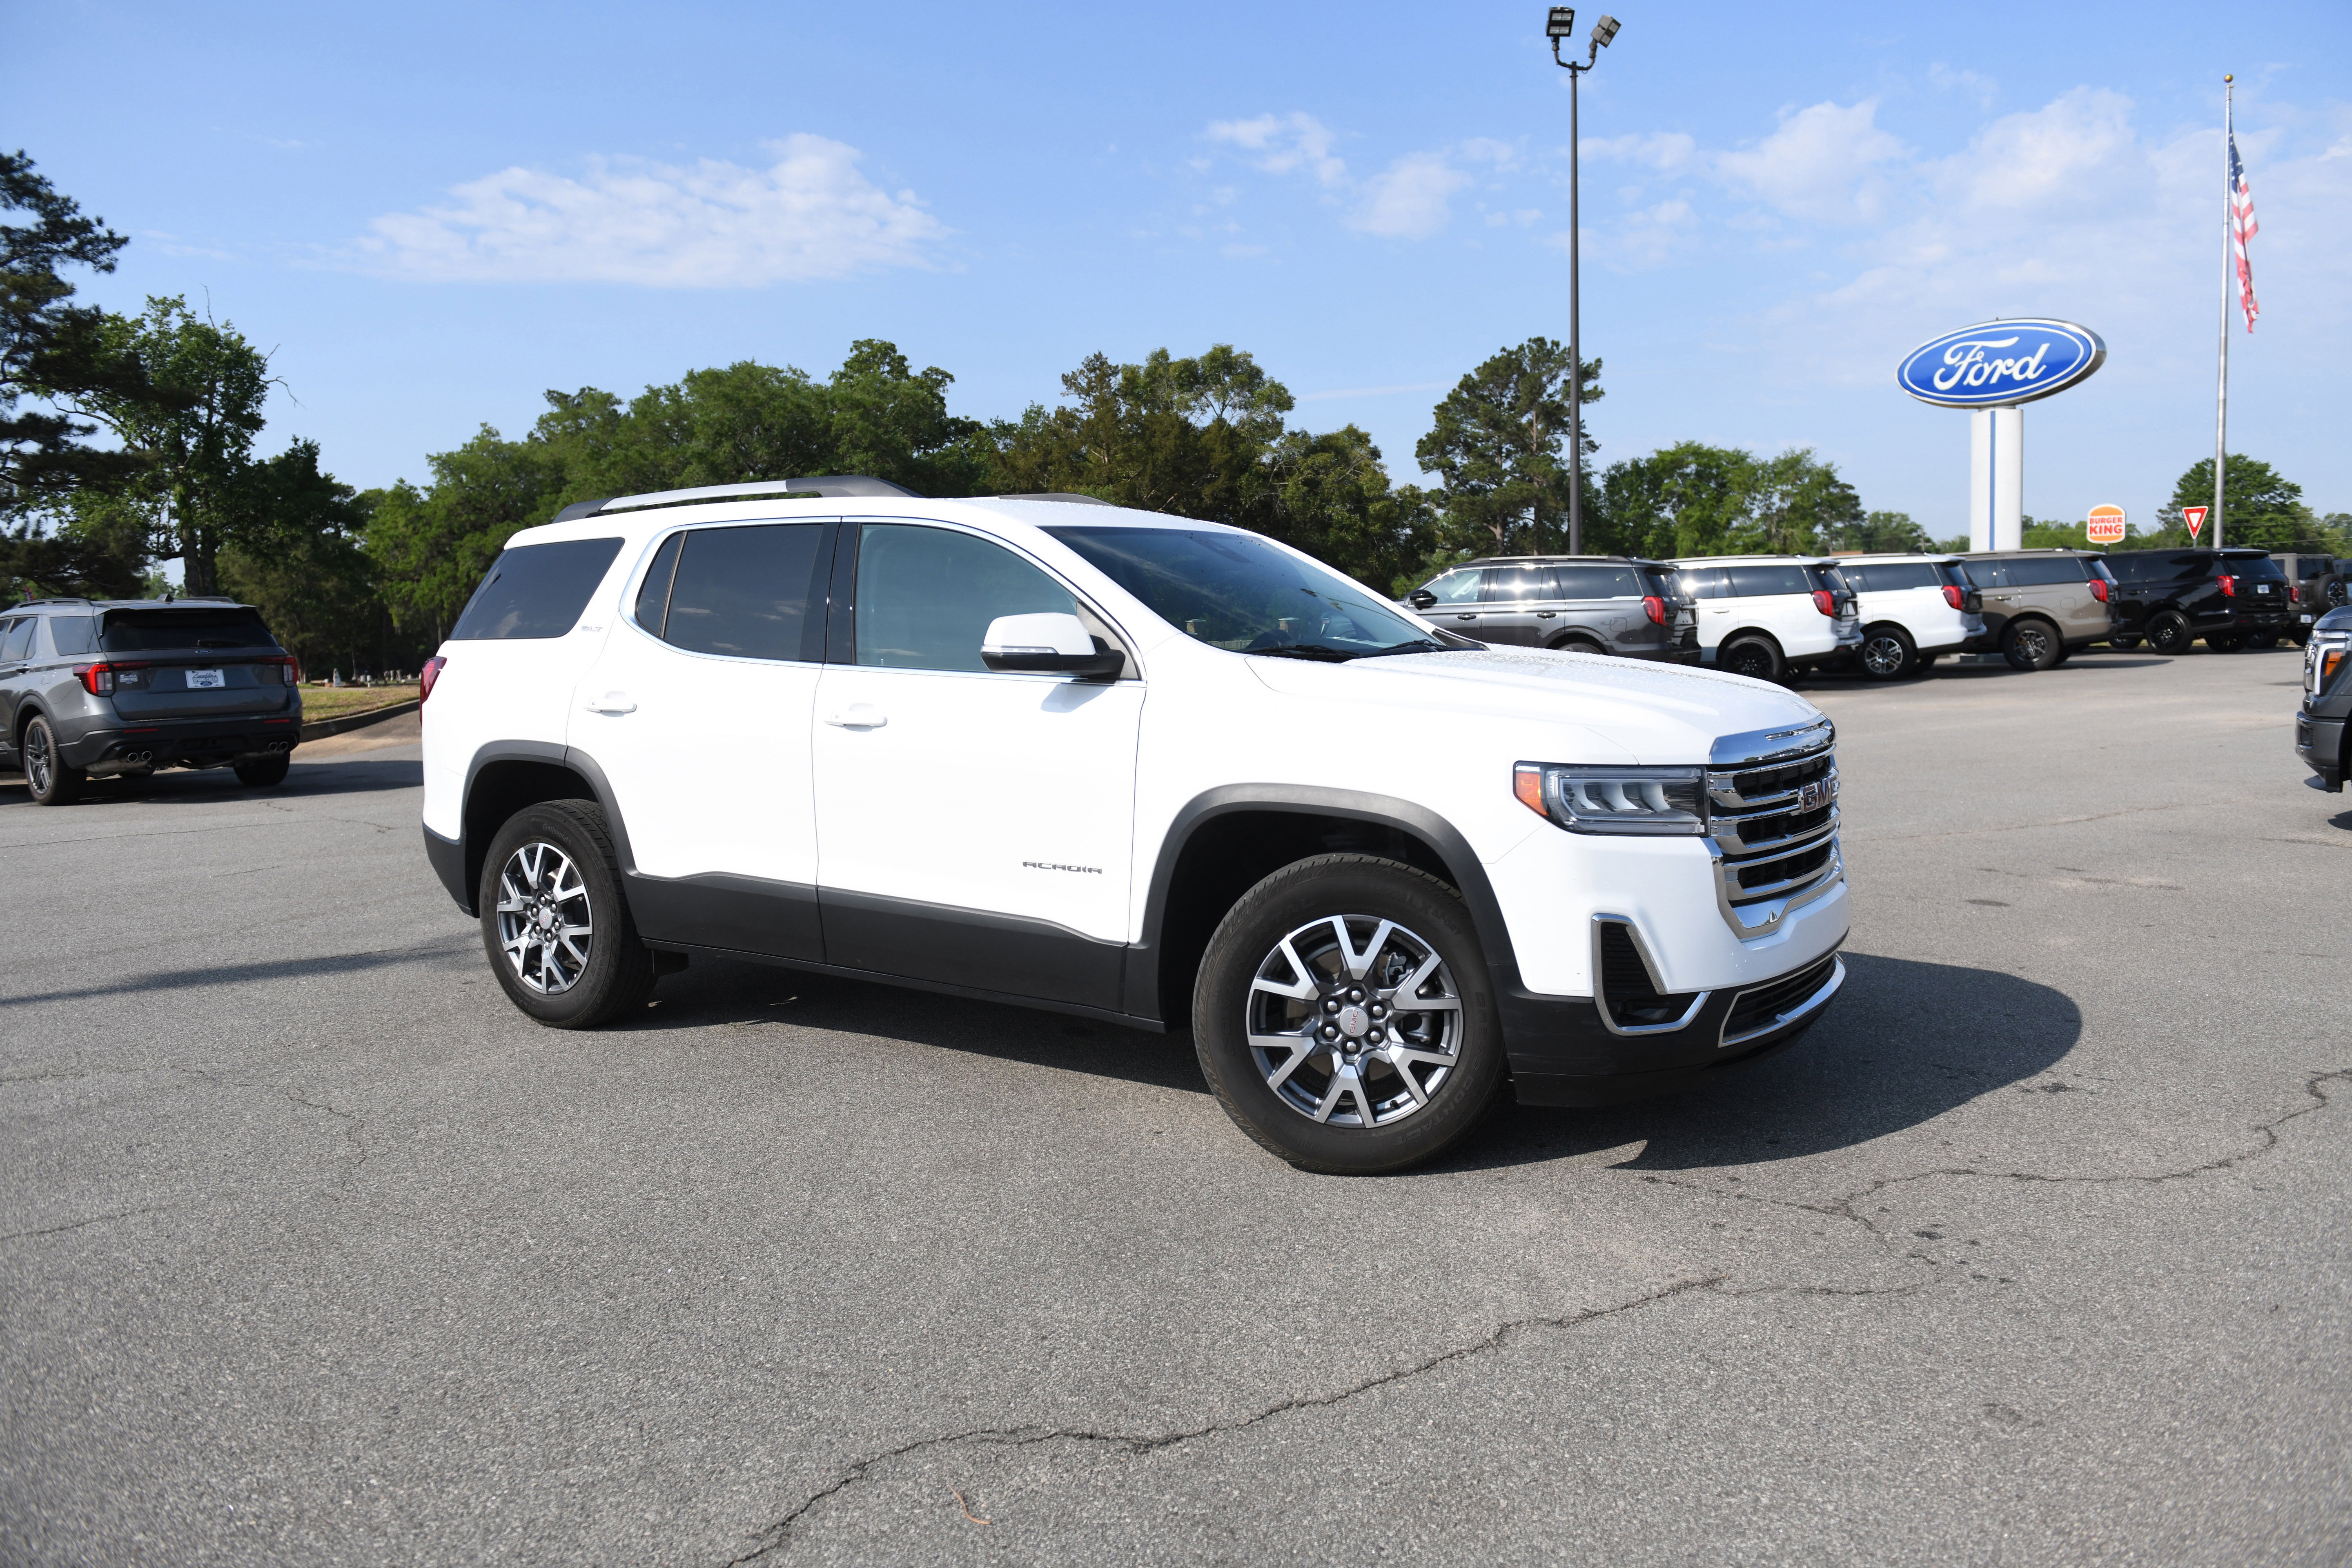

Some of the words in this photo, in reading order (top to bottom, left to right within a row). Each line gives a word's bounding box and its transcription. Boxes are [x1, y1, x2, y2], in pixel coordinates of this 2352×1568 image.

[1933, 336, 2050, 390] Ford
[2089, 525, 2122, 535] KING
[1799, 775, 1838, 813] GMC
[543, 823, 568, 843] Continental
[1022, 861, 1102, 874] ACADIA
[1223, 897, 1317, 1057] CONTINENTAL
[1350, 1009, 1359, 1033] GMC
